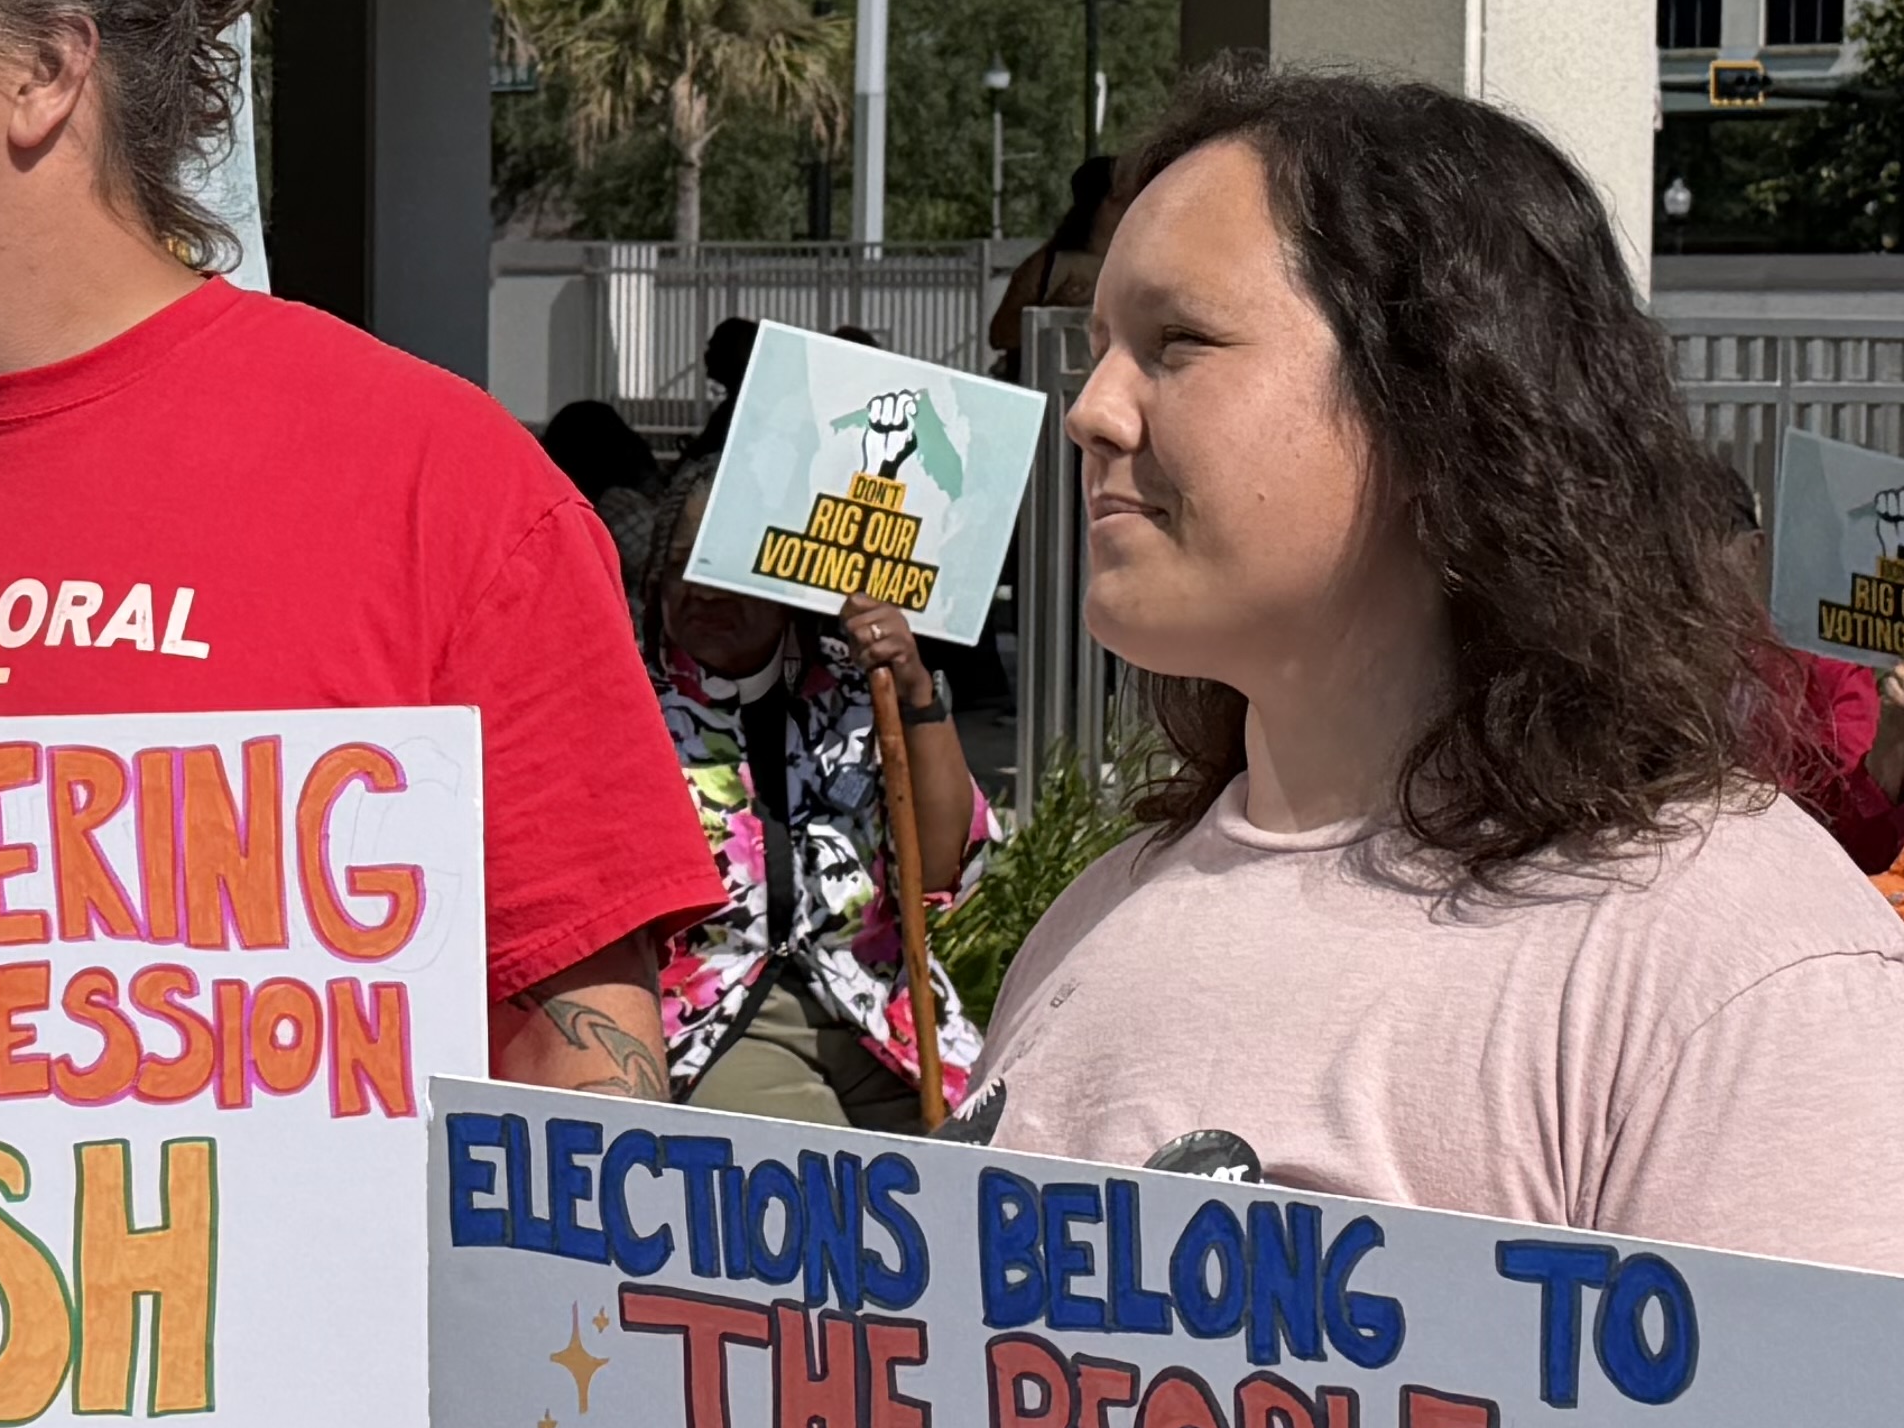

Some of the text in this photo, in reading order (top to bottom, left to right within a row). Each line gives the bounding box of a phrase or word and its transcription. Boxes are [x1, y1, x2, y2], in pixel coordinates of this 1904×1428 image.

[809, 498, 918, 560] RIG OUR
[759, 532, 933, 611] VOTING MAPS
[1855, 577, 1894, 617] RIG
[445, 1113, 1696, 1408] ELECTIONS BELONG TO
